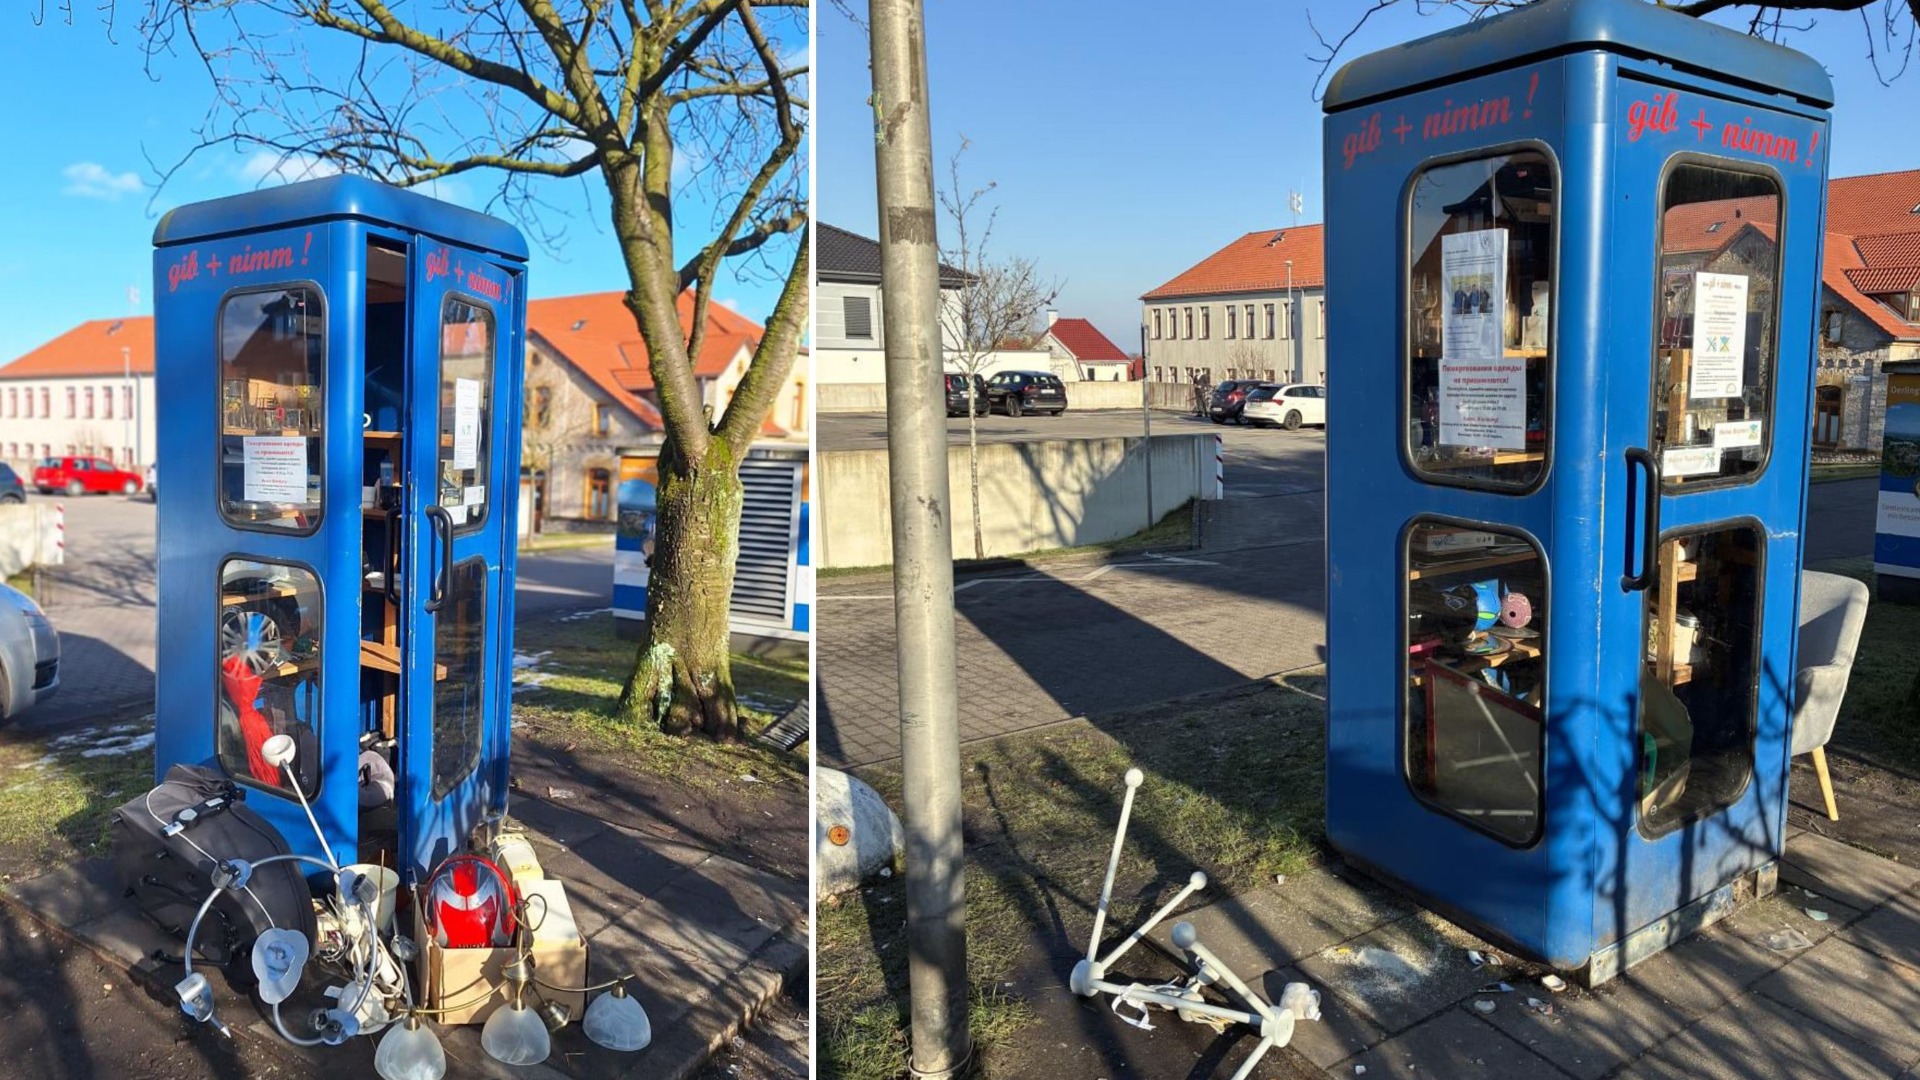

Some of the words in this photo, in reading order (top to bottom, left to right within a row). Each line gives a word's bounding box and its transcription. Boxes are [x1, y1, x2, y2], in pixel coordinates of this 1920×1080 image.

[1343, 112, 1382, 169] gib
[1392, 115, 1412, 144] +
[1423, 94, 1513, 140] nimm
[1523, 72, 1538, 119] !
[1628, 93, 1679, 142] gib
[1690, 109, 1712, 140] +
[1721, 116, 1798, 162] nimm
[1805, 131, 1819, 167] !
[168, 251, 198, 292] gib
[206, 254, 222, 276] +
[229, 243, 294, 276] nimm
[301, 232, 312, 265] !
[425, 247, 449, 282] gib
[454, 261, 464, 282] +
[467, 269, 502, 302] nimm
